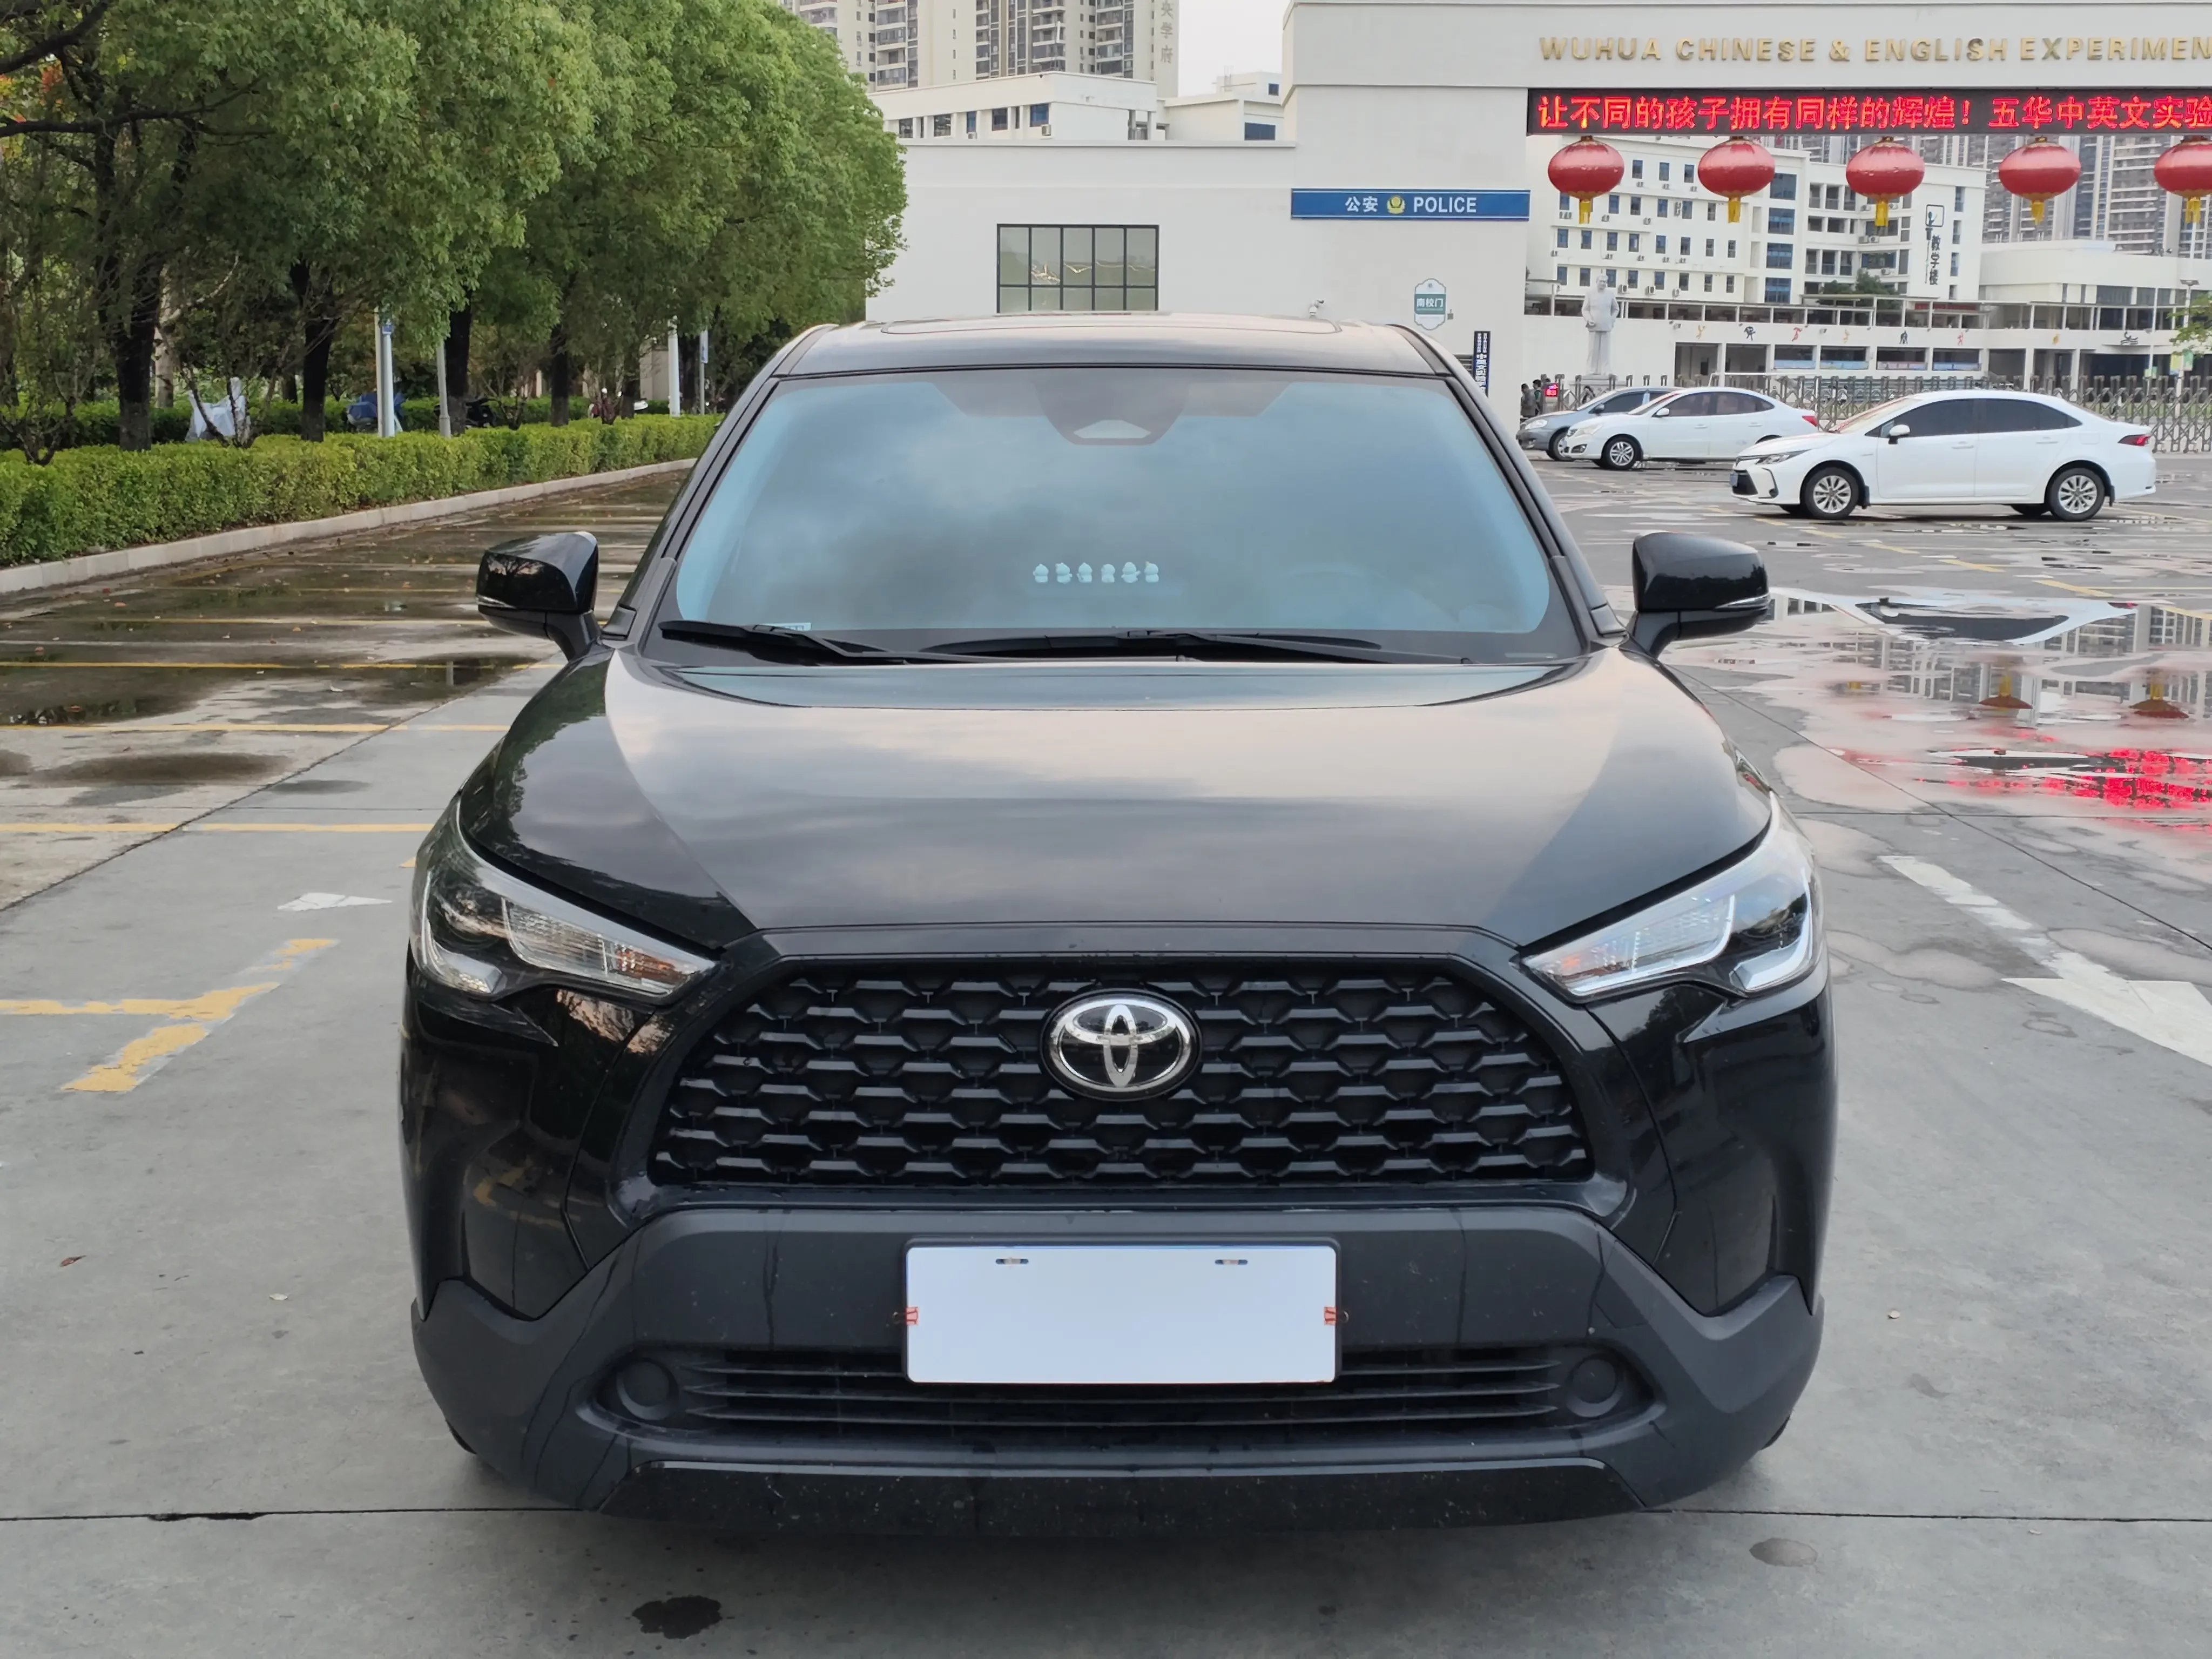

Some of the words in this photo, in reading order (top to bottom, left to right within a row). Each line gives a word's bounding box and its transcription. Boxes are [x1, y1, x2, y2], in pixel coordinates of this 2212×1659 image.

[1539, 37, 1661, 60] WUHUA
[1676, 38, 1816, 61] CHINESE
[1829, 38, 1851, 61] &
[1865, 38, 2007, 61] ENGLISH
[2020, 37, 2212, 61] EXPERIMEN
[1345, 196, 1378, 213] 公安
[1413, 197, 1477, 213] POLICE
[1929, 234, 1941, 286] 教学楼
[1416, 298, 1444, 308] 南校门
